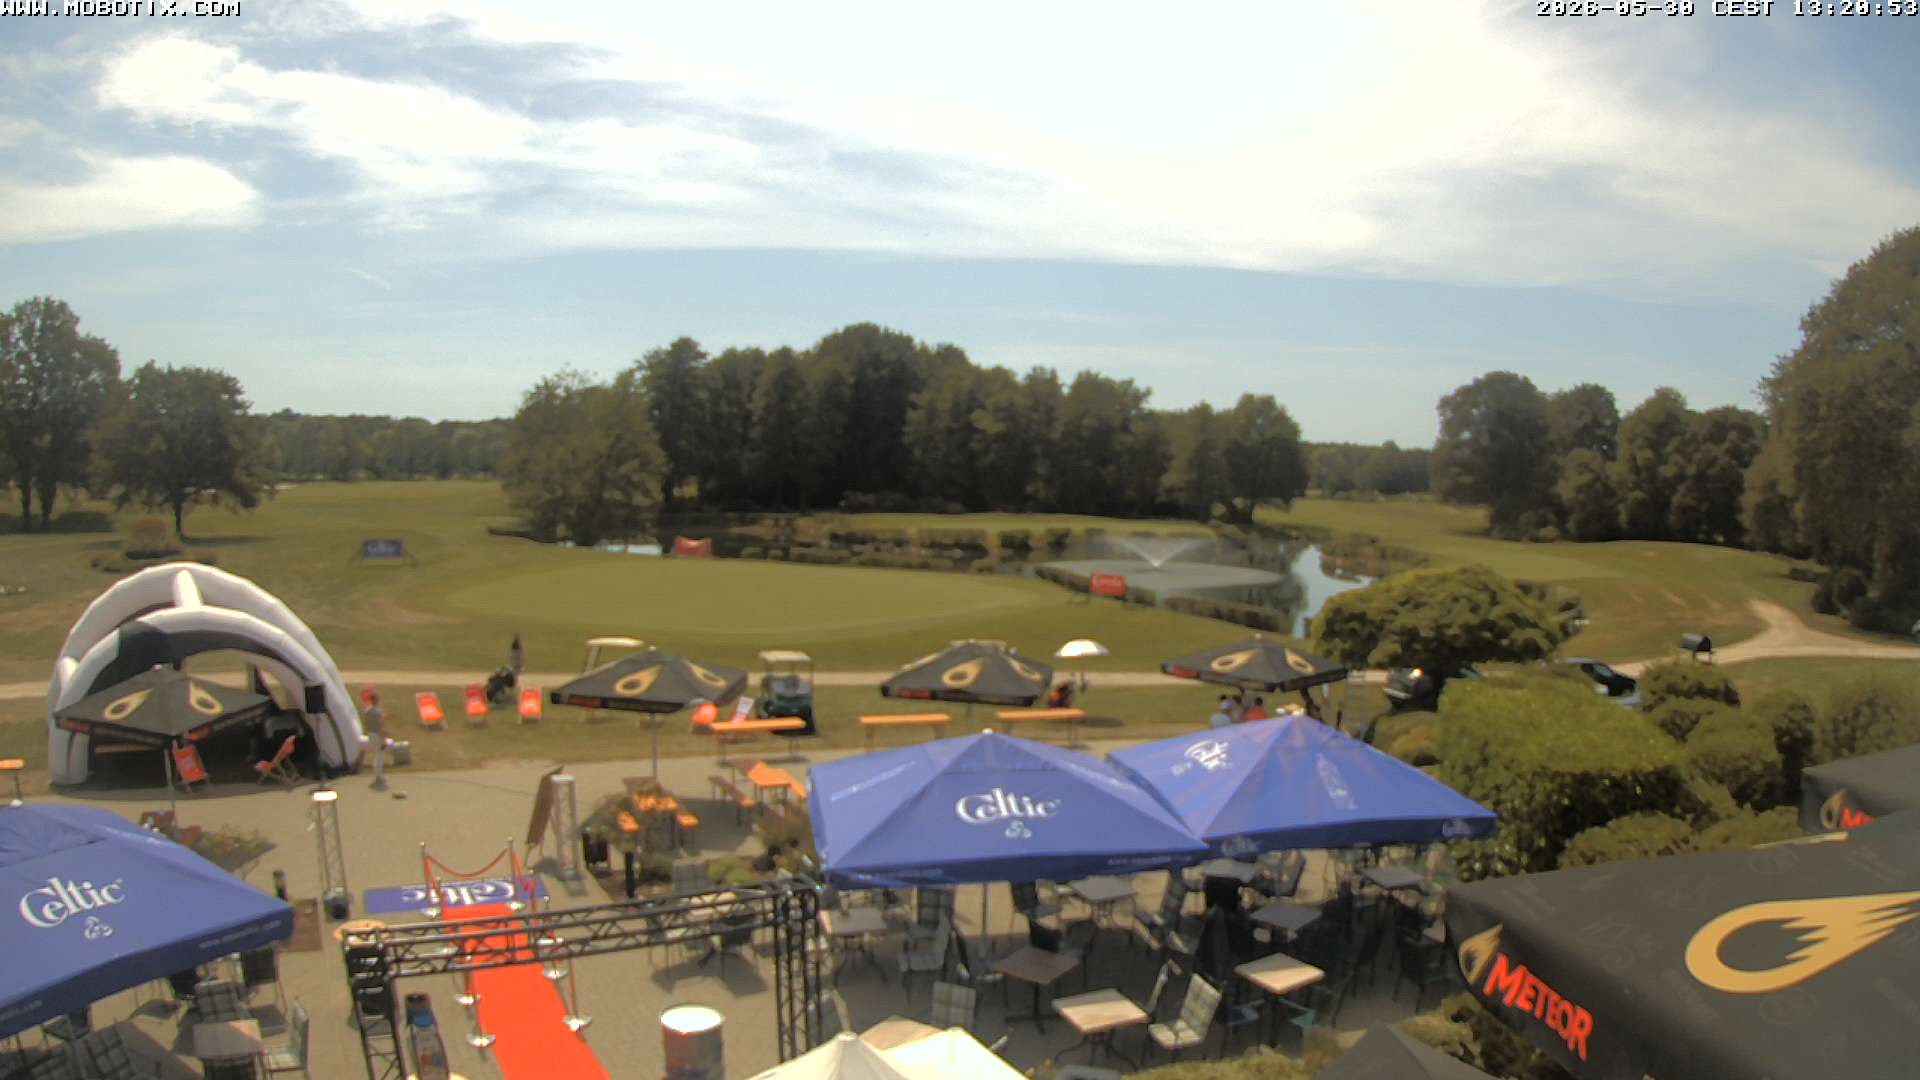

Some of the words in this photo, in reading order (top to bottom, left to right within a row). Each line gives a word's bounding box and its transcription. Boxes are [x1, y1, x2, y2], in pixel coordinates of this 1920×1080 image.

[955, 787, 1058, 823] Celtic
[19, 877, 125, 928] Celtic
[1483, 952, 1594, 1062] METEOR
